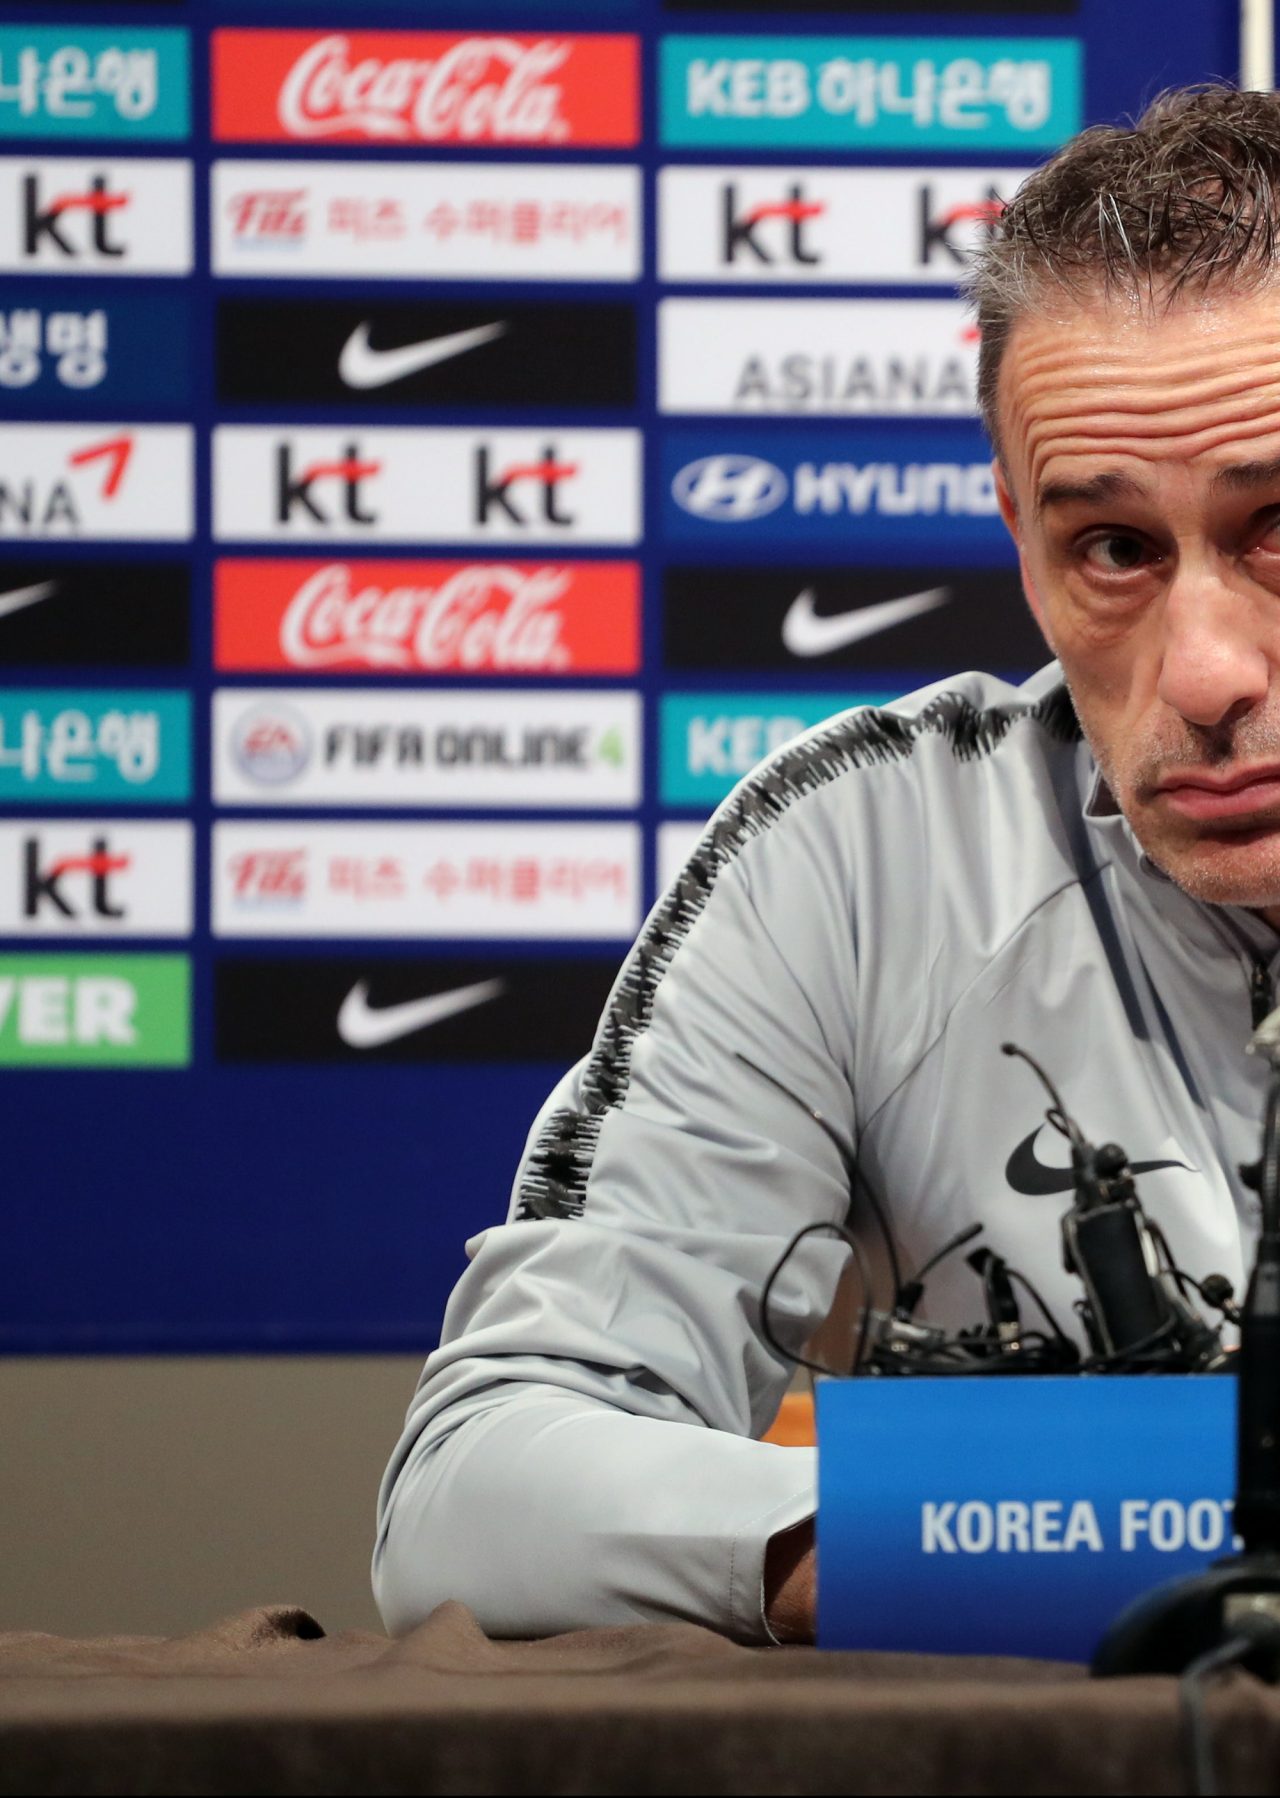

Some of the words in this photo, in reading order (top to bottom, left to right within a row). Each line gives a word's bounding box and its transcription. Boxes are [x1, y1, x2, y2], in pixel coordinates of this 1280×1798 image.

[687, 60, 808, 118] KEB
[817, 58, 1051, 130] 하나은행
[23, 173, 128, 258] kt
[722, 183, 824, 266] kt
[734, 355, 970, 401] ASIANA
[277, 442, 381, 526] kt
[475, 444, 578, 528] kt
[323, 727, 426, 767] FIFA
[434, 726, 589, 768] ONLINE
[23, 836, 128, 920] kt
[922, 1500, 1103, 1552] KOREA
